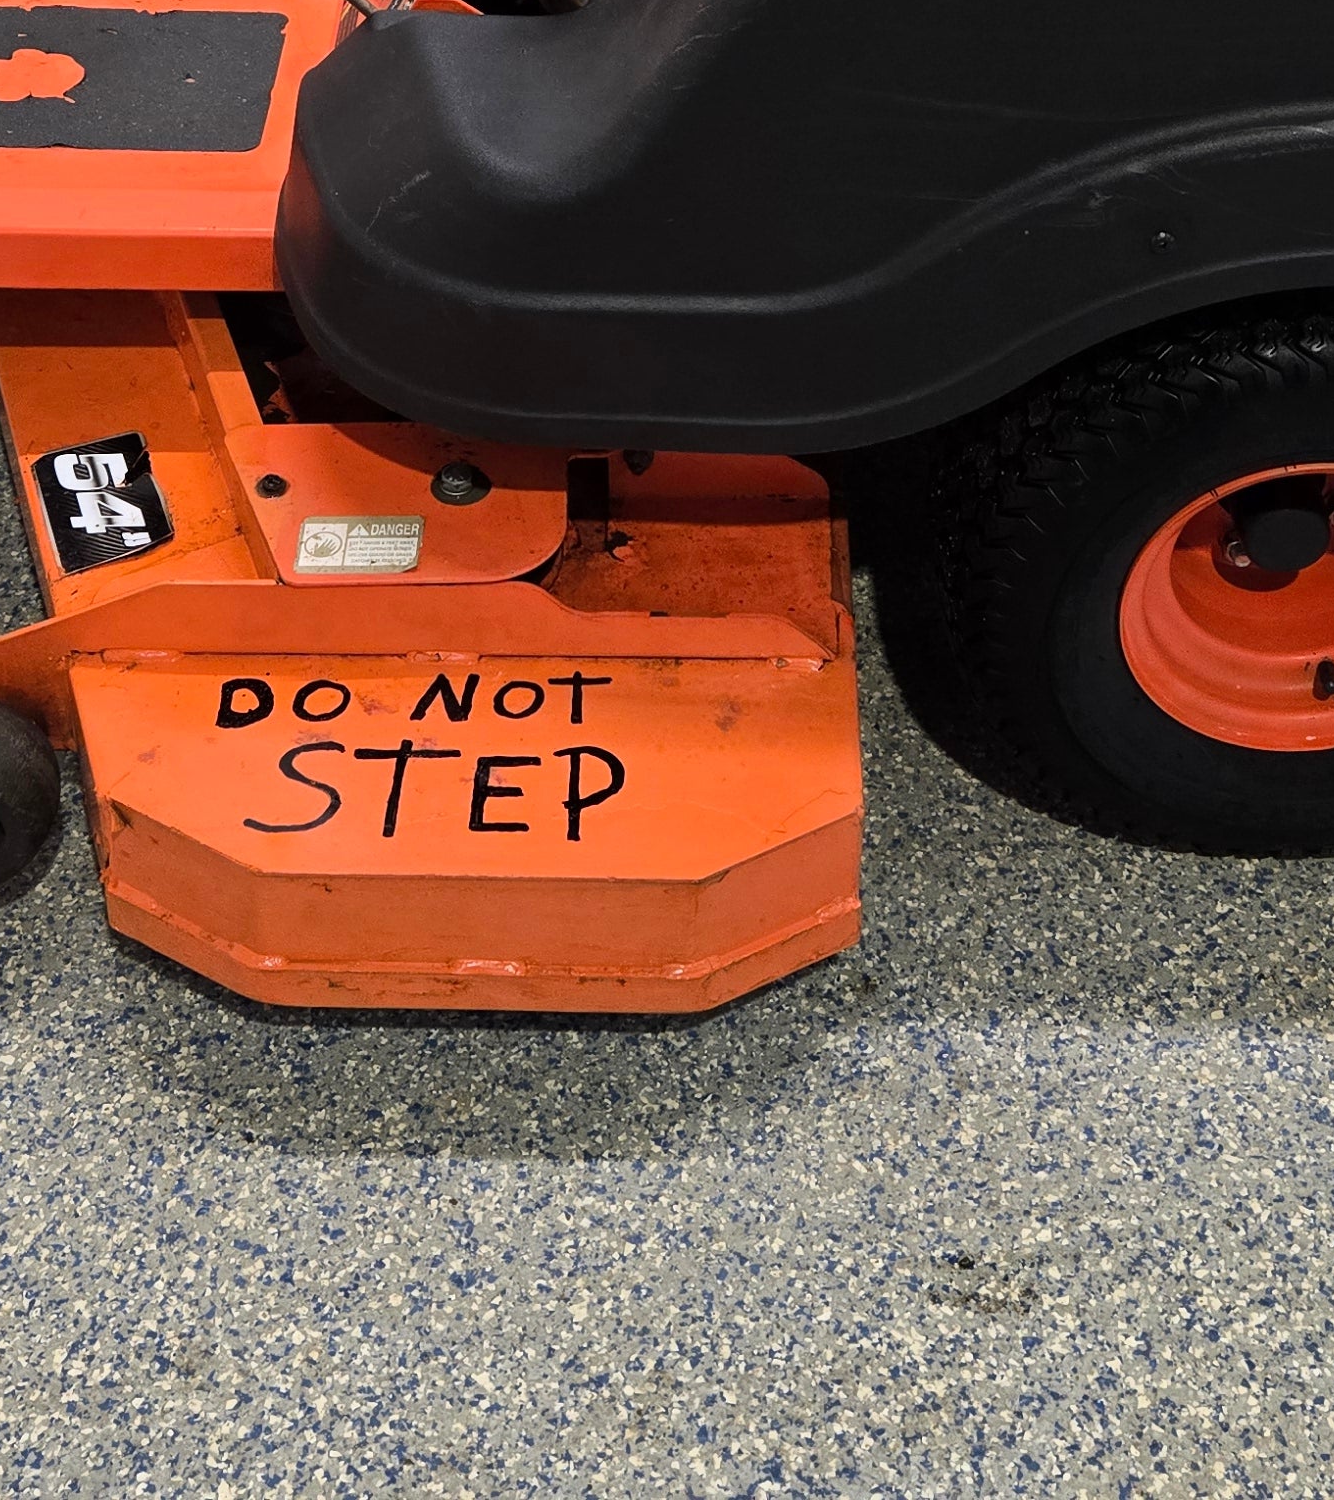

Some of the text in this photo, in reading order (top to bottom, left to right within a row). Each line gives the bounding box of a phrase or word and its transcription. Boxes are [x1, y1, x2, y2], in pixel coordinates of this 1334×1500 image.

[370, 523, 420, 536] DANGER
[214, 670, 613, 729] DO NOT
[242, 738, 627, 843] STEP
